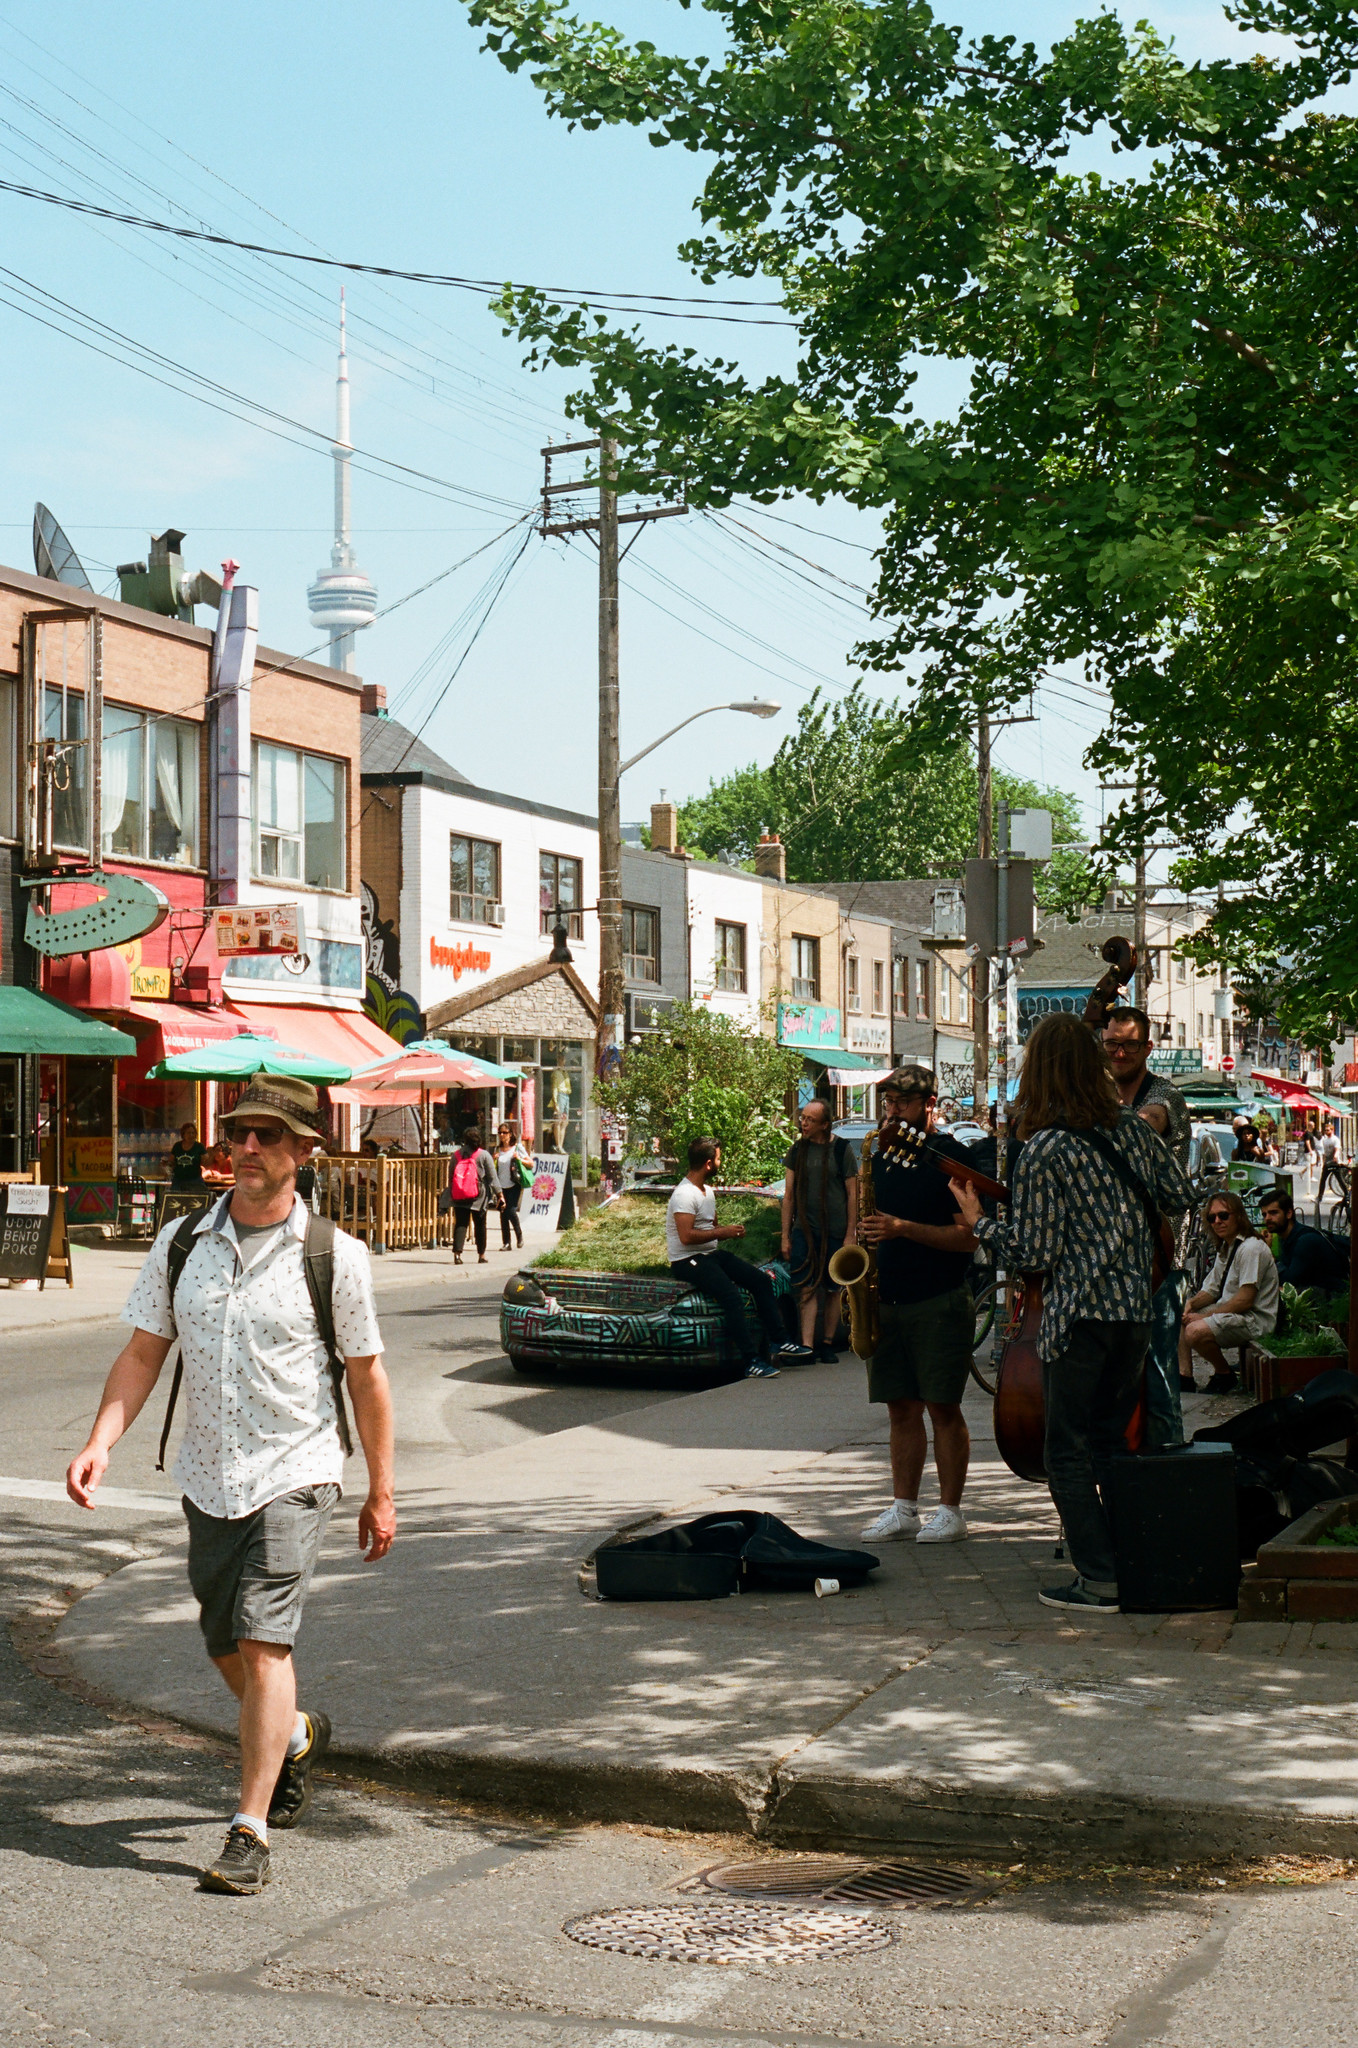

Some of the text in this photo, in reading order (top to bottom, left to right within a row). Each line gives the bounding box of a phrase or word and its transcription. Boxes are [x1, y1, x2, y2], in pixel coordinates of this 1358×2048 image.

[430, 936, 491, 980] bungalow
[131, 966, 166, 993] TROMPO
[1147, 1050, 1177, 1059] FRUIT
[530, 1204, 549, 1215] ARTS
[3, 1229, 39, 1242] BENTO
